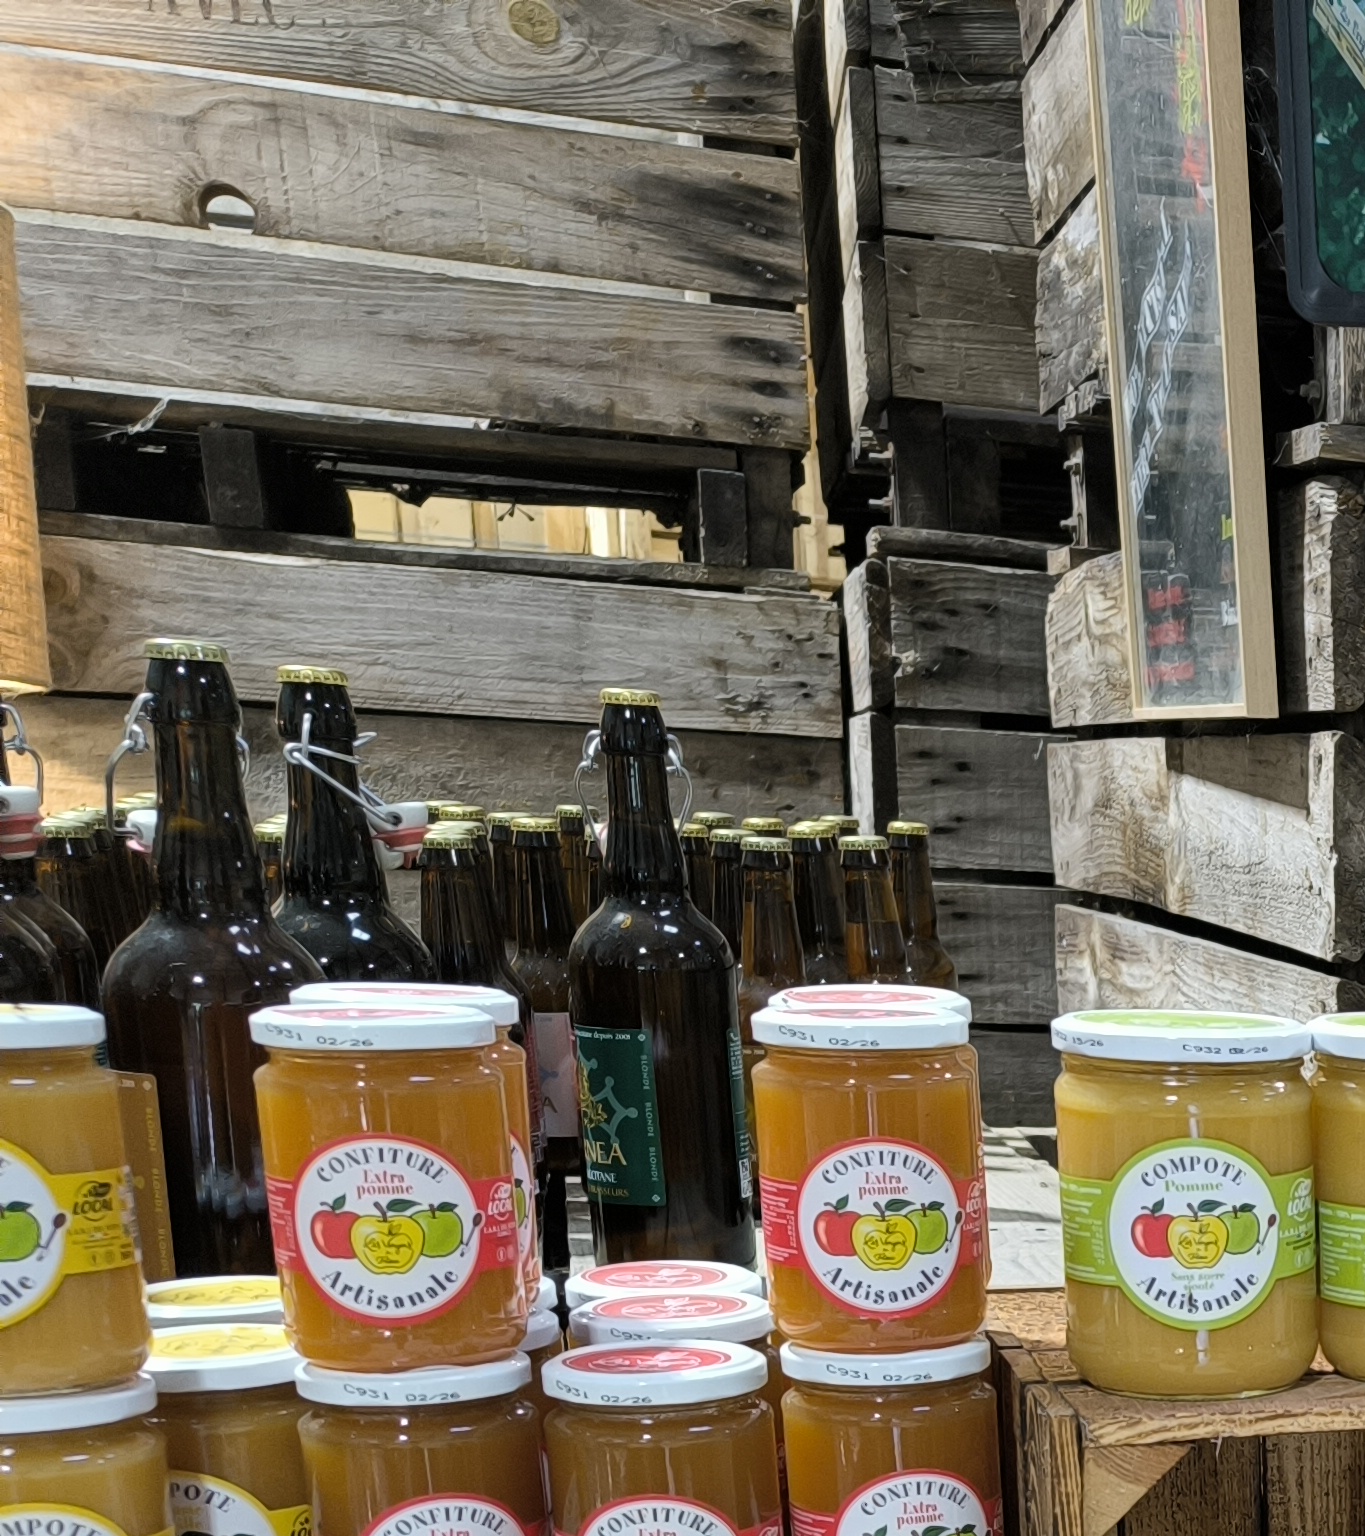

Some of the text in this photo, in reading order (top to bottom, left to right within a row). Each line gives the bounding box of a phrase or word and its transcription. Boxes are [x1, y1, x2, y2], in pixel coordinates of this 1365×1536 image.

[316, 1145, 450, 1184] CONFITURE
[821, 1151, 938, 1184] CONFITURE
[1141, 1156, 1248, 1186] COMPOTE
[362, 1169, 404, 1184] Extra
[864, 1173, 902, 1185] Extra
[1165, 1180, 1223, 1193] Pomme
[356, 1183, 414, 1196] pomme
[858, 1183, 909, 1196] pomme
[321, 1269, 459, 1311] Artisanale
[823, 1263, 944, 1306] Artisanale
[1137, 1272, 1259, 1314] Artisanale
[860, 1481, 973, 1517] CONFITURE
[903, 1501, 938, 1515] Extra
[897, 1512, 945, 1528] pomme
